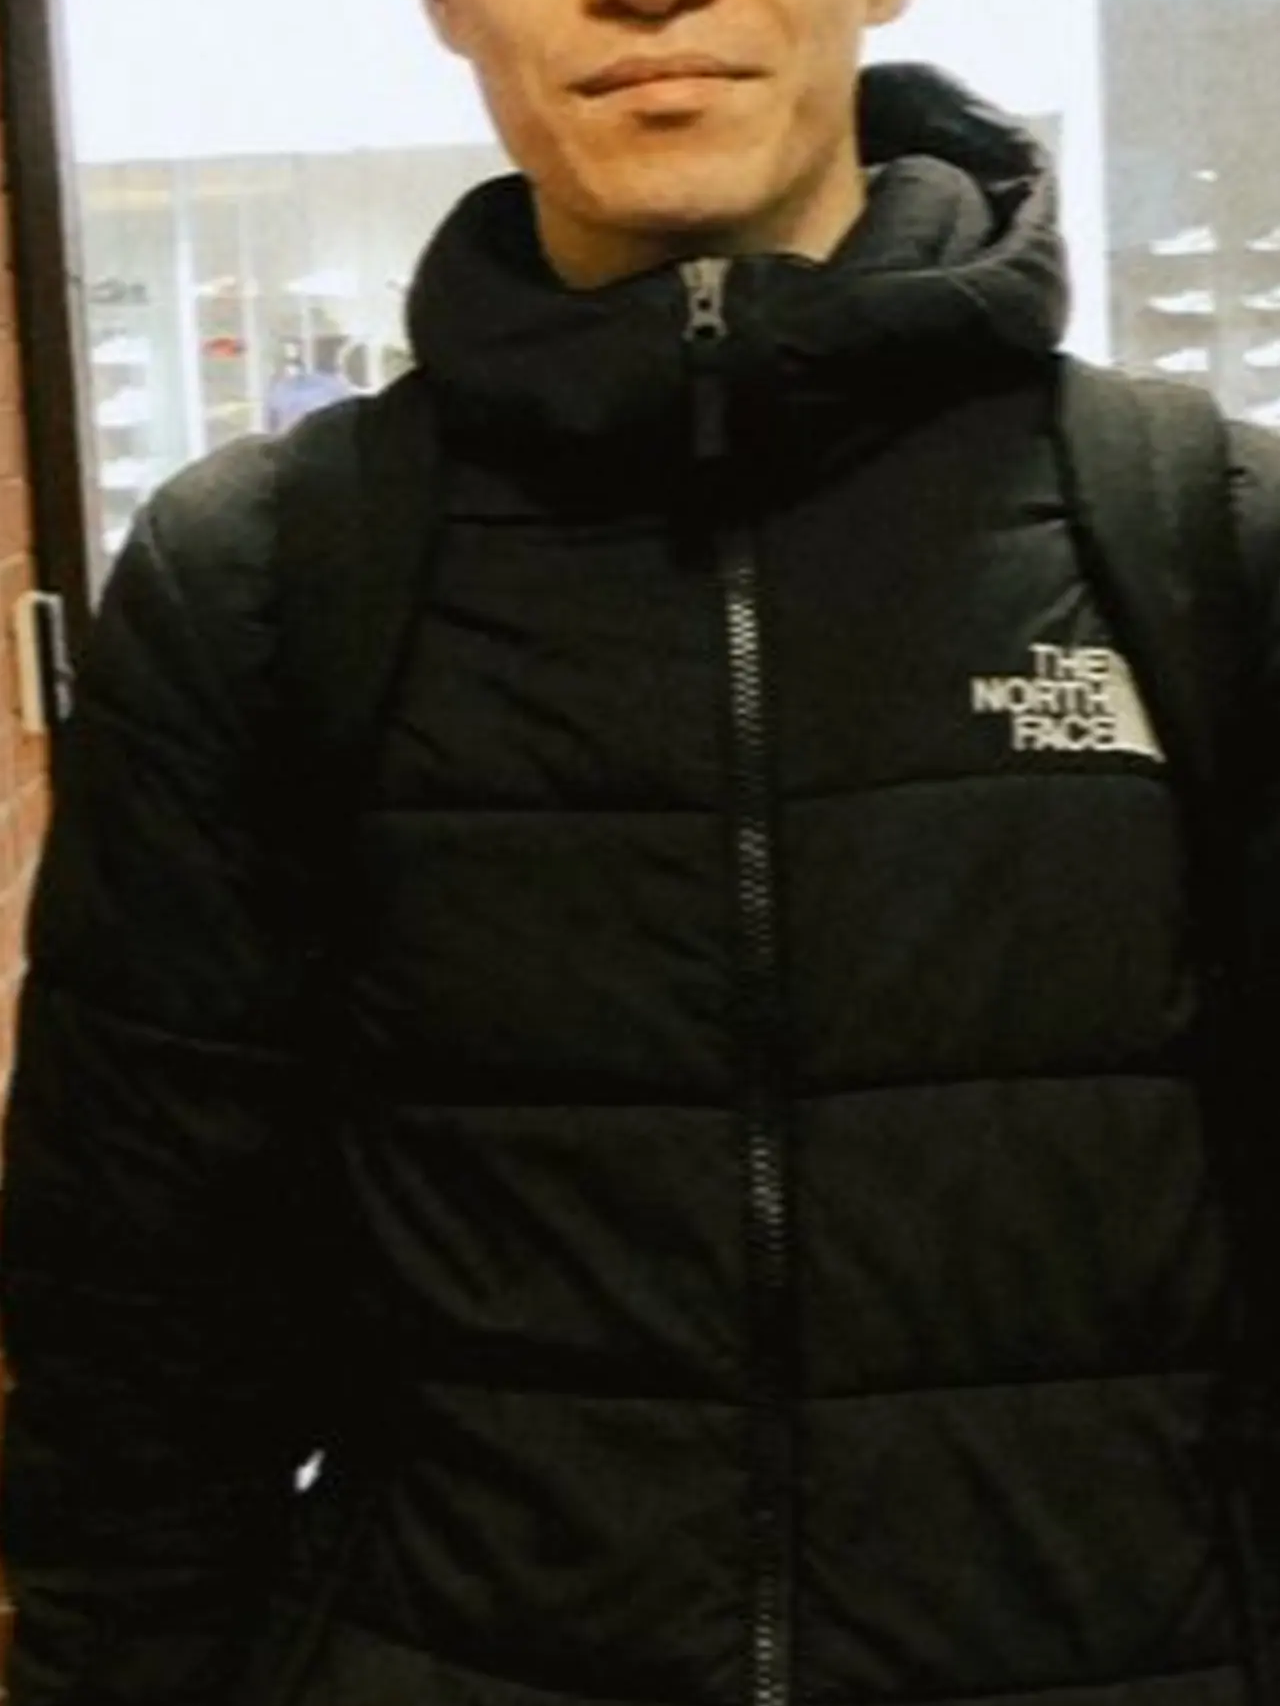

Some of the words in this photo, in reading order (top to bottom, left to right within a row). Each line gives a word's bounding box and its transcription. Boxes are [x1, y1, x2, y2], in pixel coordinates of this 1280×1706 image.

[1029, 643, 1112, 680] THE
[972, 677, 1112, 713] NORTH
[1013, 715, 1117, 751] FACE
